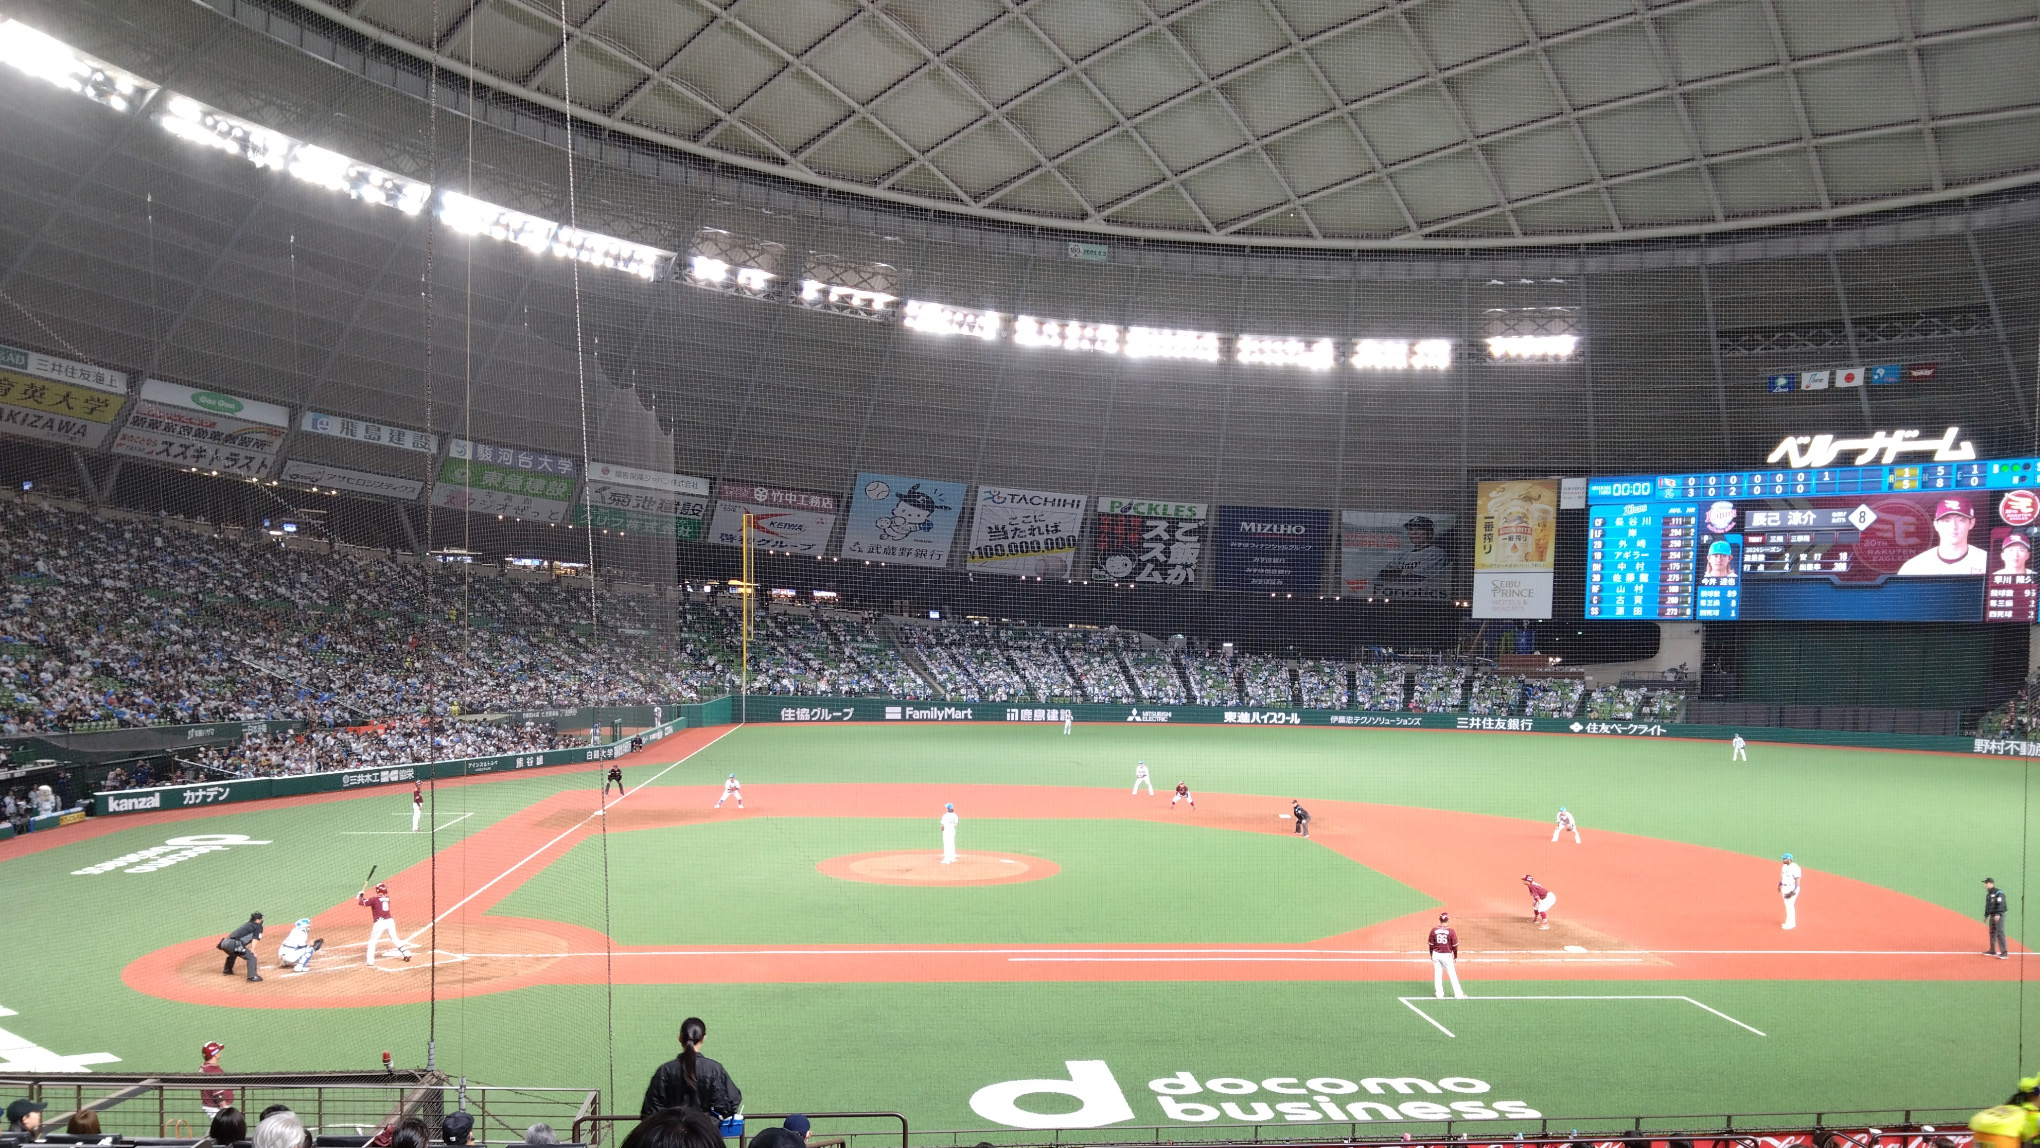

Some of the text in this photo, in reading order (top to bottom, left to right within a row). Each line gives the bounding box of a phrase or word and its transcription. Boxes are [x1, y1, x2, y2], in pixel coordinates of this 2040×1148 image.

[36, 358, 118, 389] 三井住友海上
[340, 419, 432, 452] 飛島建設
[1766, 426, 1976, 468] ベルーナドーム
[156, 440, 268, 475] スズキトラスト
[476, 444, 573, 474] 駿河台大学
[327, 473, 416, 494] アサヒロジスティクス
[483, 470, 568, 496] 東急建設
[615, 470, 699, 490] 損害保険ジャパン株式会社
[1688, 466, 1978, 486] 0 0 0 0 0 0 1 1 5 1
[1612, 482, 1650, 496] 00:00
[1688, 477, 1978, 497] 3 0 2 0 0 0 5 8 0
[608, 492, 704, 516] 菊池建設
[772, 490, 834, 508] 竹中工務店
[1007, 494, 1081, 510] TACHIHI
[1008, 514, 1046, 526] ここに
[1788, 511, 1816, 526] 涼介
[1858, 510, 1866, 524] 8
[770, 521, 804, 532] KEIWA
[986, 522, 1062, 542] 当たれば
[1240, 522, 1306, 534] MIZUHO
[1483, 516, 1494, 554] 一番搾り
[867, 543, 944, 561] 武蔵野銀行
[968, 534, 1076, 560] ¥100,000,000
[1136, 520, 1170, 584] ススム
[1166, 520, 1205, 585] ご飯が
[1614, 551, 1650, 560] アギラー
[1491, 580, 1521, 592] SEIBU
[1493, 588, 1534, 598] PRINCE
[1616, 584, 1644, 593] 山村
[780, 707, 854, 721] 住協グループ
[906, 707, 972, 720] FamilyMart
[1224, 711, 1300, 725] 東進ハイスクール
[1330, 715, 1422, 726] 伊藤忠テクノソリューションズ
[1456, 717, 1533, 731] 三井住友銀行
[1586, 723, 1667, 736] 住友ベークライト
[350, 773, 379, 785] 三共木工
[183, 787, 230, 805] カナデン
[1148, 1071, 1492, 1095] docomo
[1157, 1094, 1544, 1122] business
